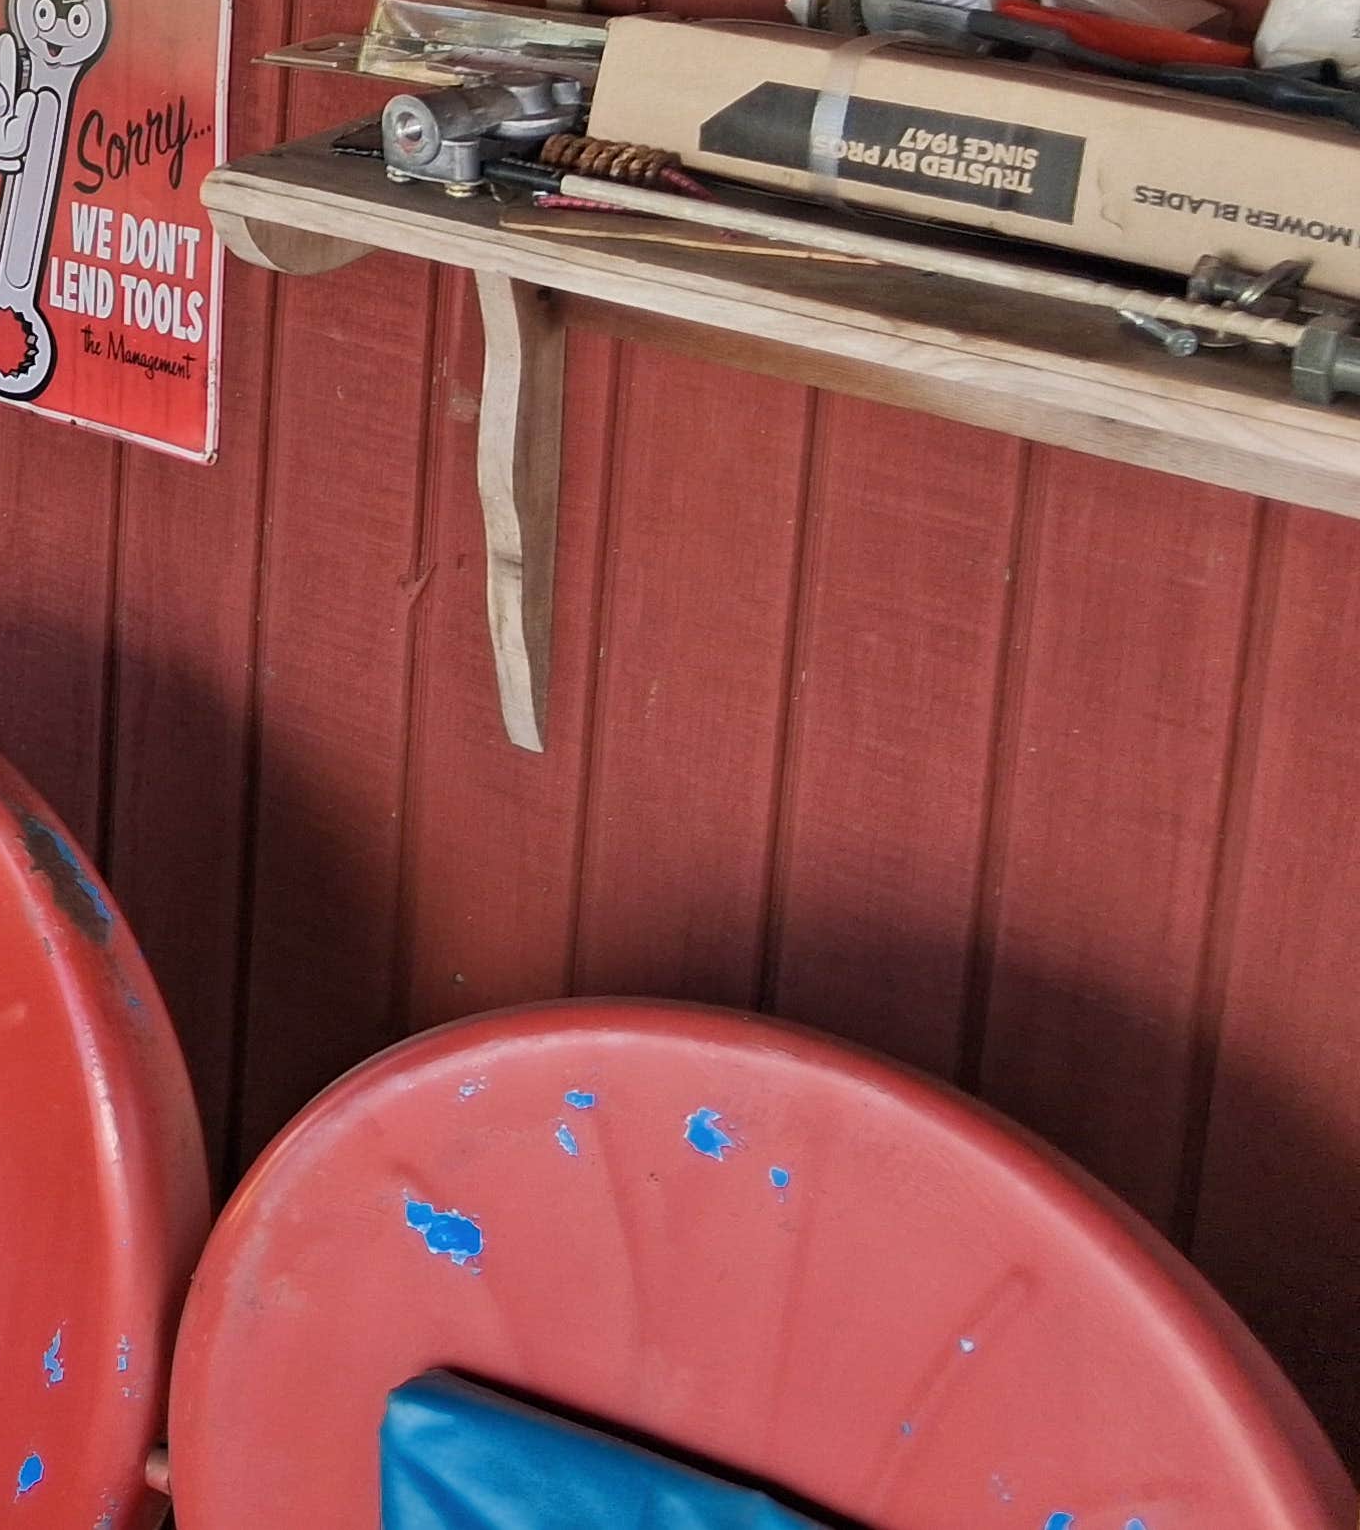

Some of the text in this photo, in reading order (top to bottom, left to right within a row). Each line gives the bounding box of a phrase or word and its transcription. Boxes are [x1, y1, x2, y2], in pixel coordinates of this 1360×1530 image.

[811, 134, 1033, 193] TRUSTED BY PROS
[897, 127, 1040, 169] SINCE 1947
[1133, 185, 1240, 223] BLADES
[1245, 208, 1353, 247] MOWER
[70, 201, 200, 281] WE DON'T
[49, 256, 204, 343] LEND TOOLS
[81, 324, 197, 381] the Management
